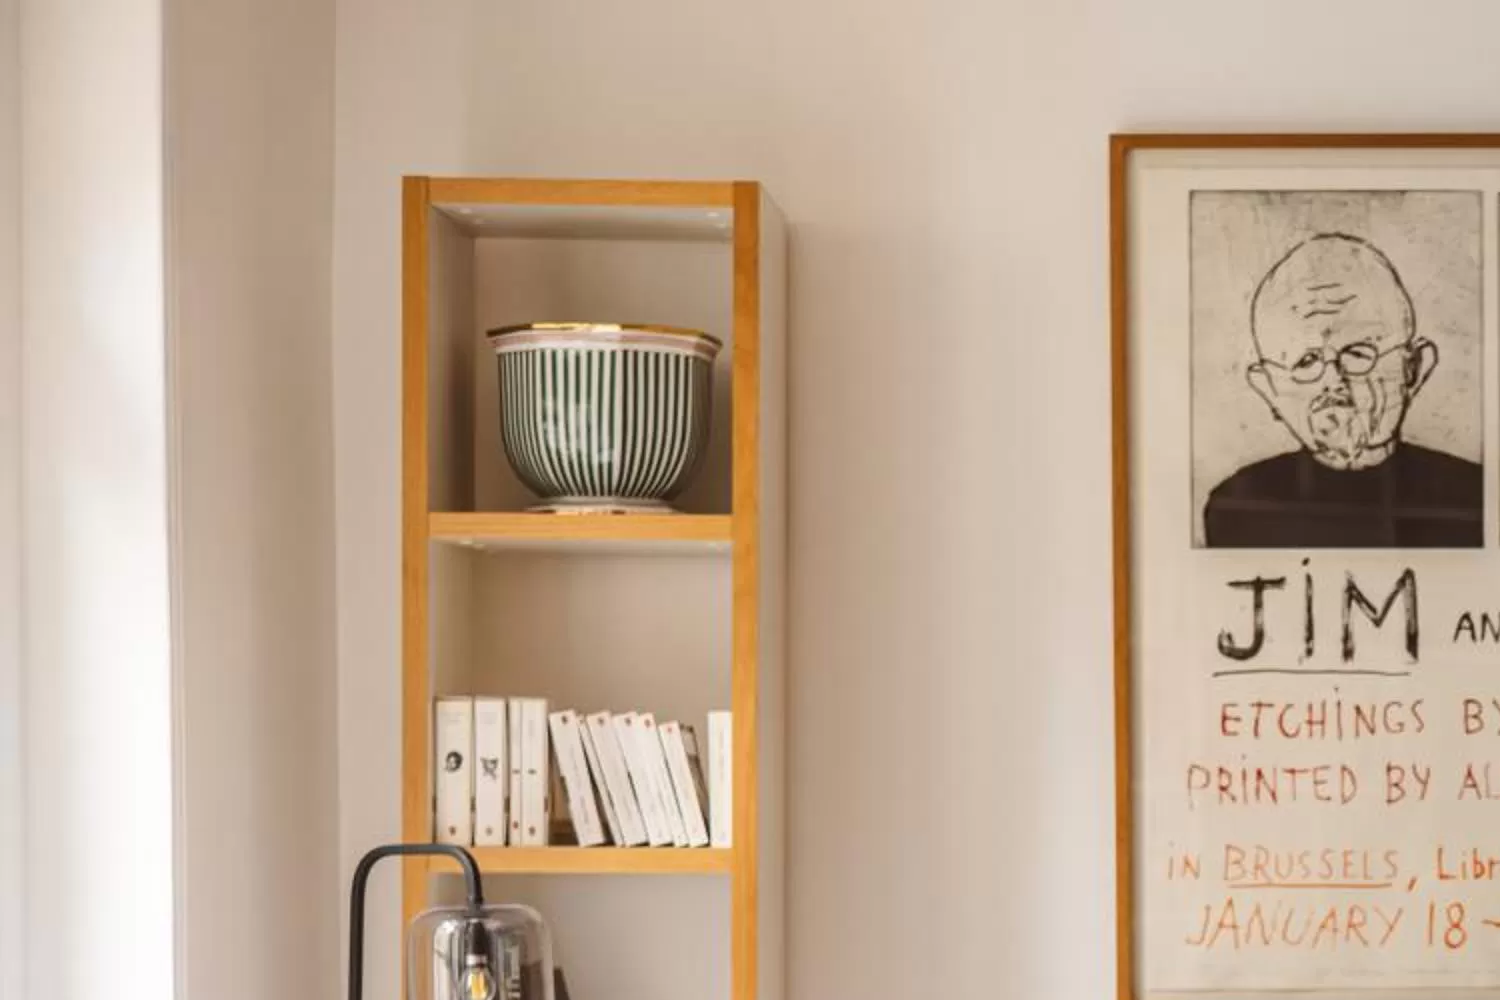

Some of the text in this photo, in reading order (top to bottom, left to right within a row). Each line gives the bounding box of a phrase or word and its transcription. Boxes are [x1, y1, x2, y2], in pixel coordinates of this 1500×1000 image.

[1386, 761, 1431, 804] BY
[1185, 896, 1404, 950] JANUARY
[1426, 900, 1468, 949] 18
